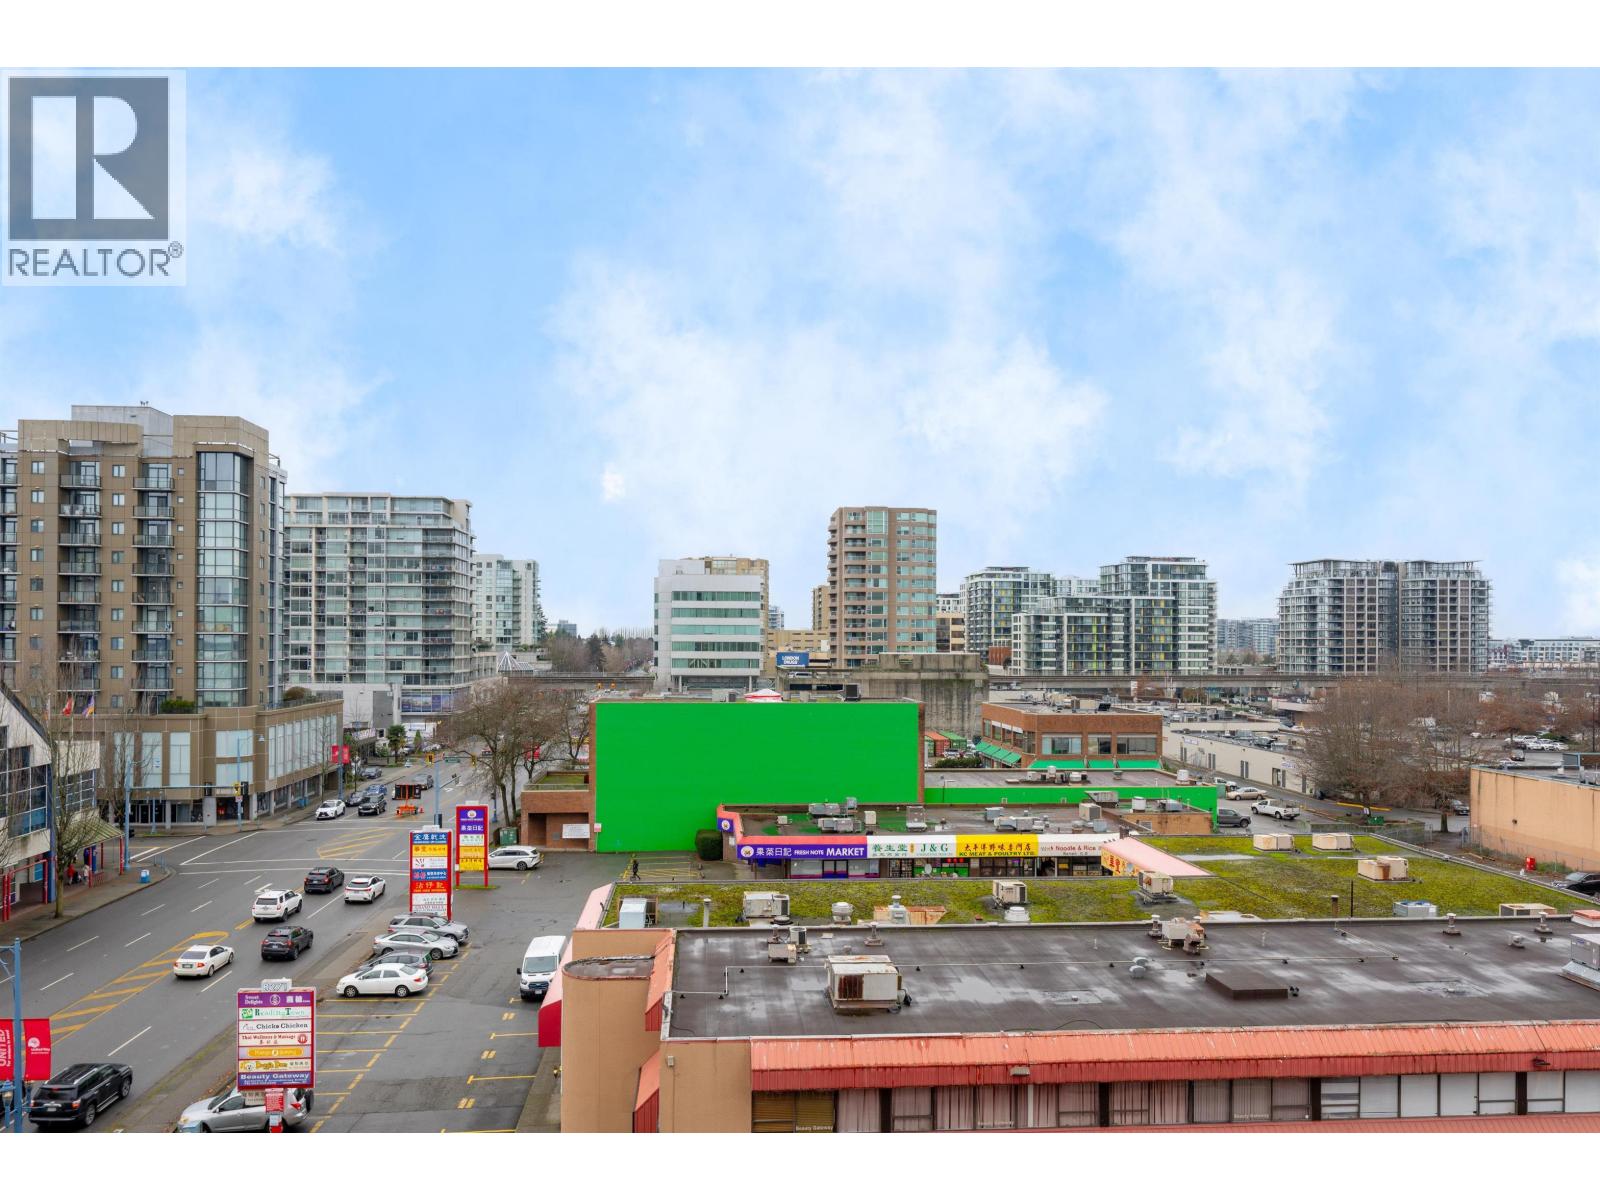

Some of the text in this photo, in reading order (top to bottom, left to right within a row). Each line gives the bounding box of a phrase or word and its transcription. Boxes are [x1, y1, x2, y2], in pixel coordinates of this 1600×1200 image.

[826, 847, 865, 857] MARKET
[920, 843, 927, 853] J
[929, 843, 938, 853] &
[940, 843, 948, 853] G
[240, 1073, 271, 1081] Beauty
